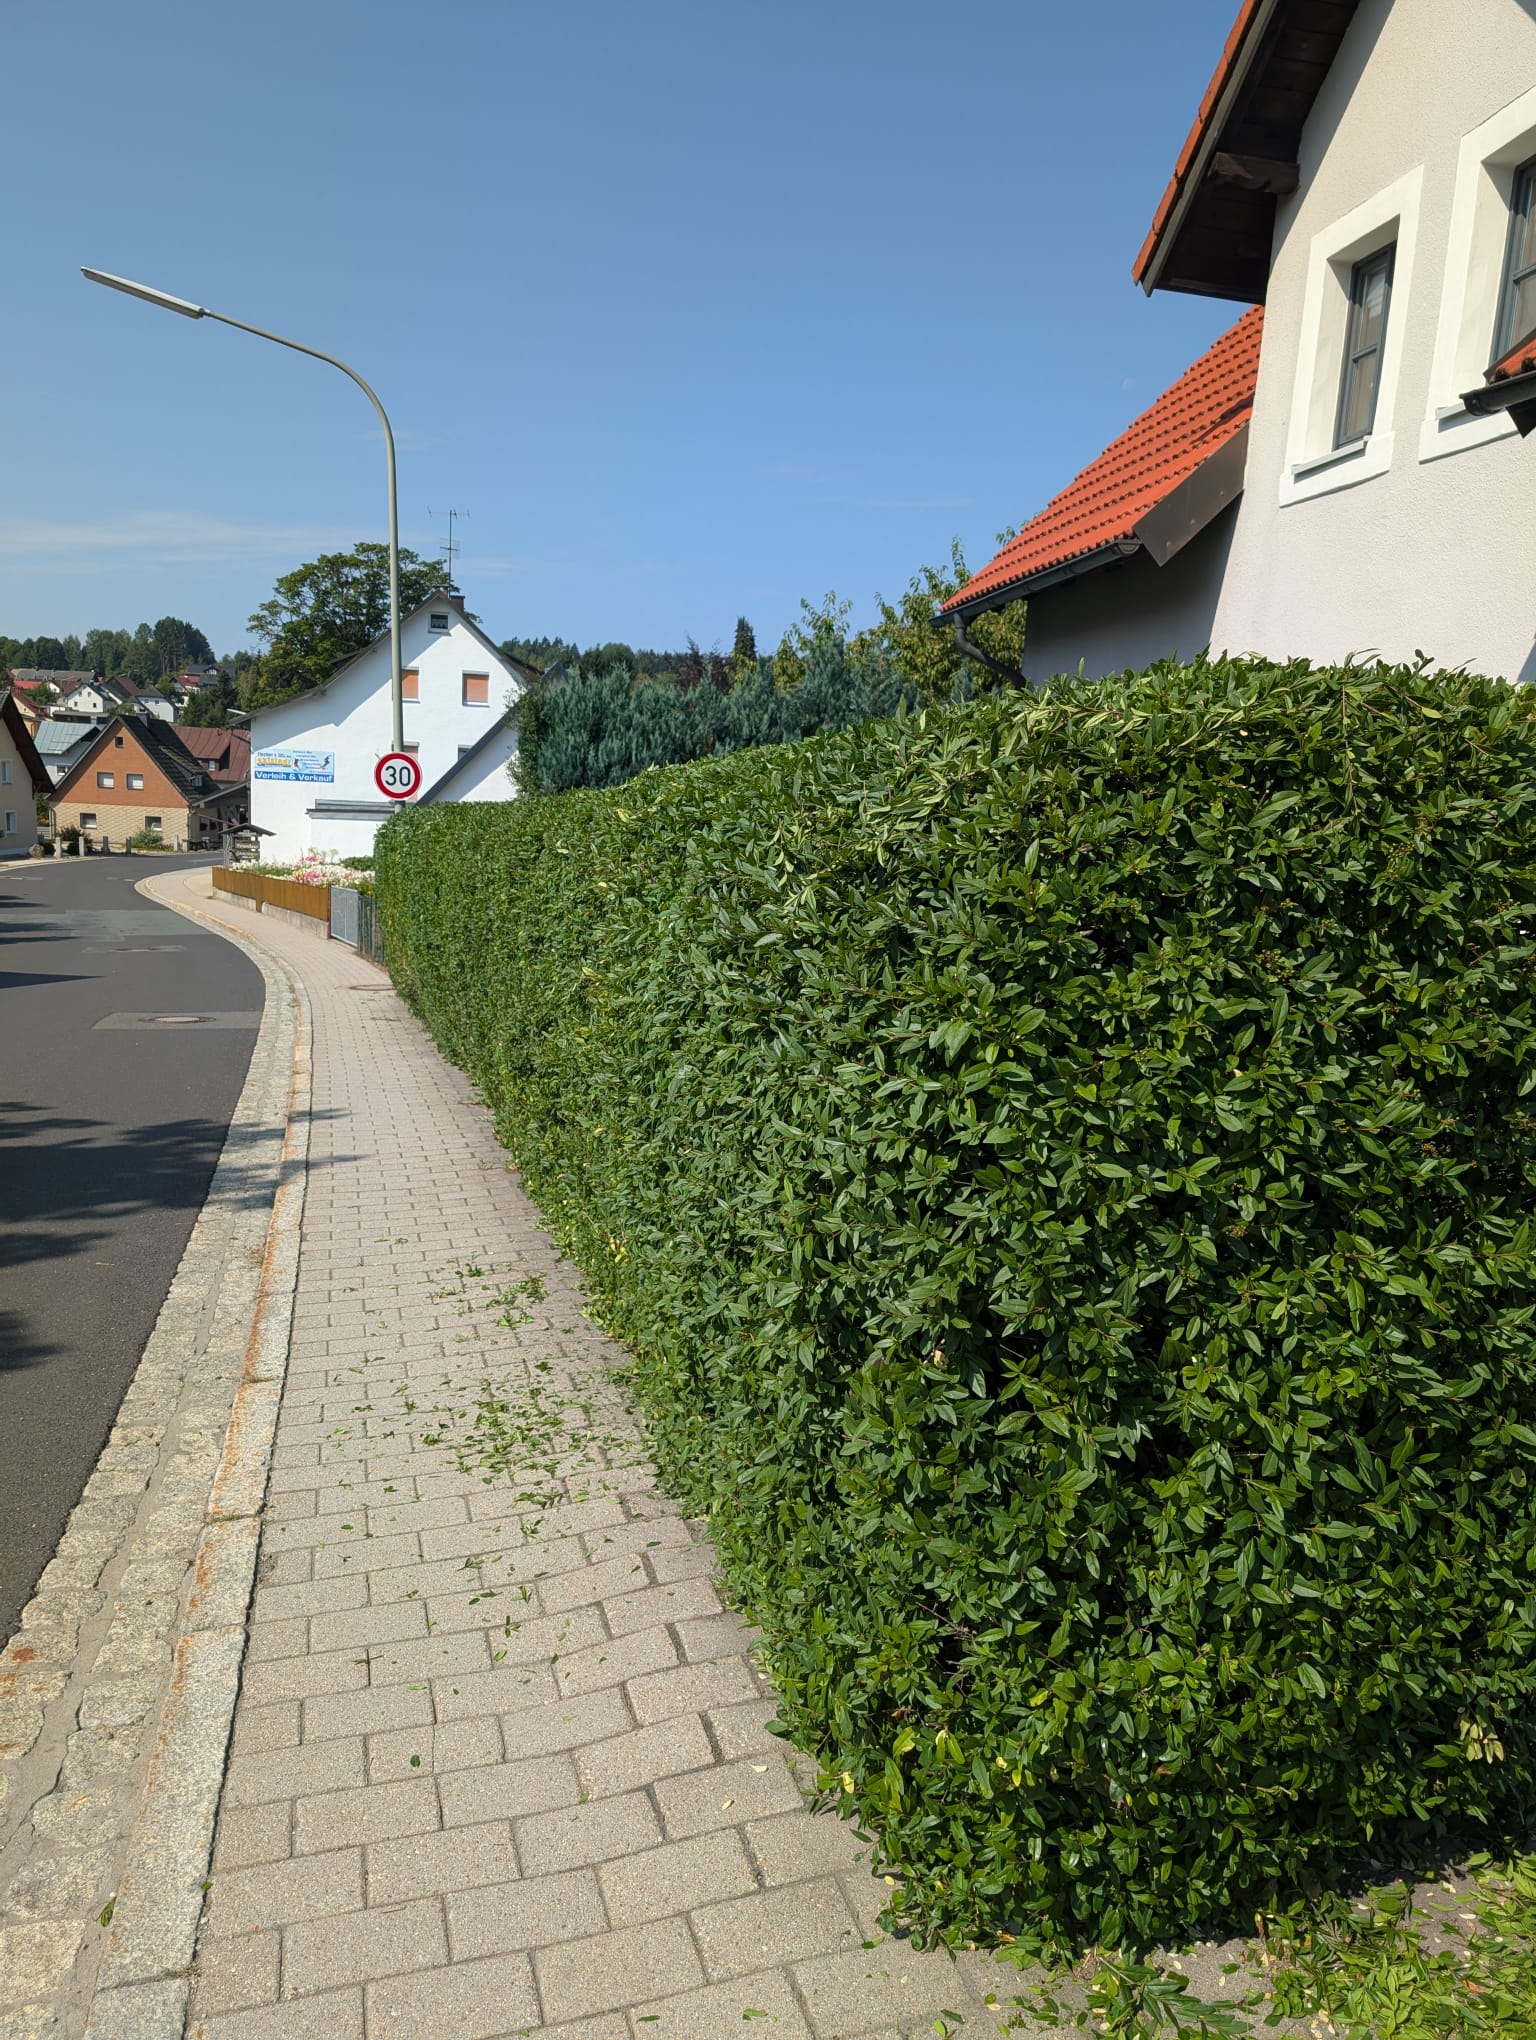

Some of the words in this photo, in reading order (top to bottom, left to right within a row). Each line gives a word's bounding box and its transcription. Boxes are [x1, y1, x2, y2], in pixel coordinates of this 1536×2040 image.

[256, 771, 286, 780] Verleih
[288, 772, 296, 780] &
[298, 773, 332, 782] Verkauf
[385, 765, 411, 787] 30
